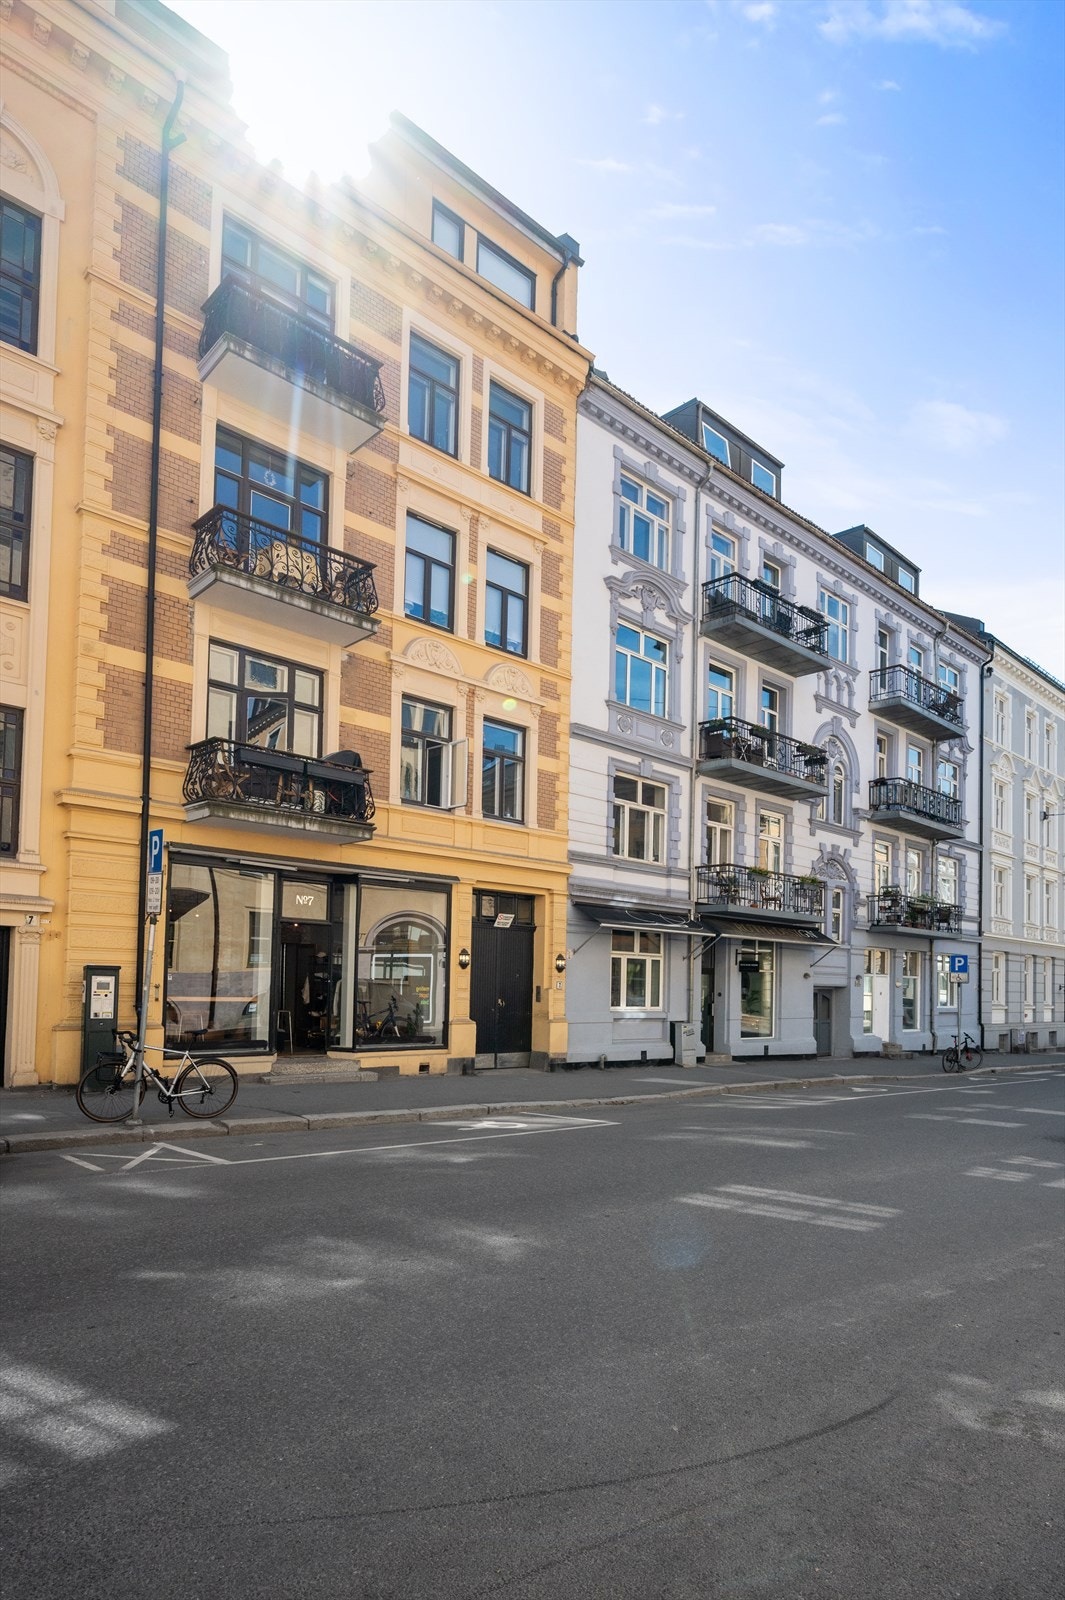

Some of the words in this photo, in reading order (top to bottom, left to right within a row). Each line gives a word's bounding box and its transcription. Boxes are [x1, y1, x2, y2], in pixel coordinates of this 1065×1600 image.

[152, 835, 160, 868] P
[28, 915, 34, 925] 7
[955, 957, 965, 971] P
